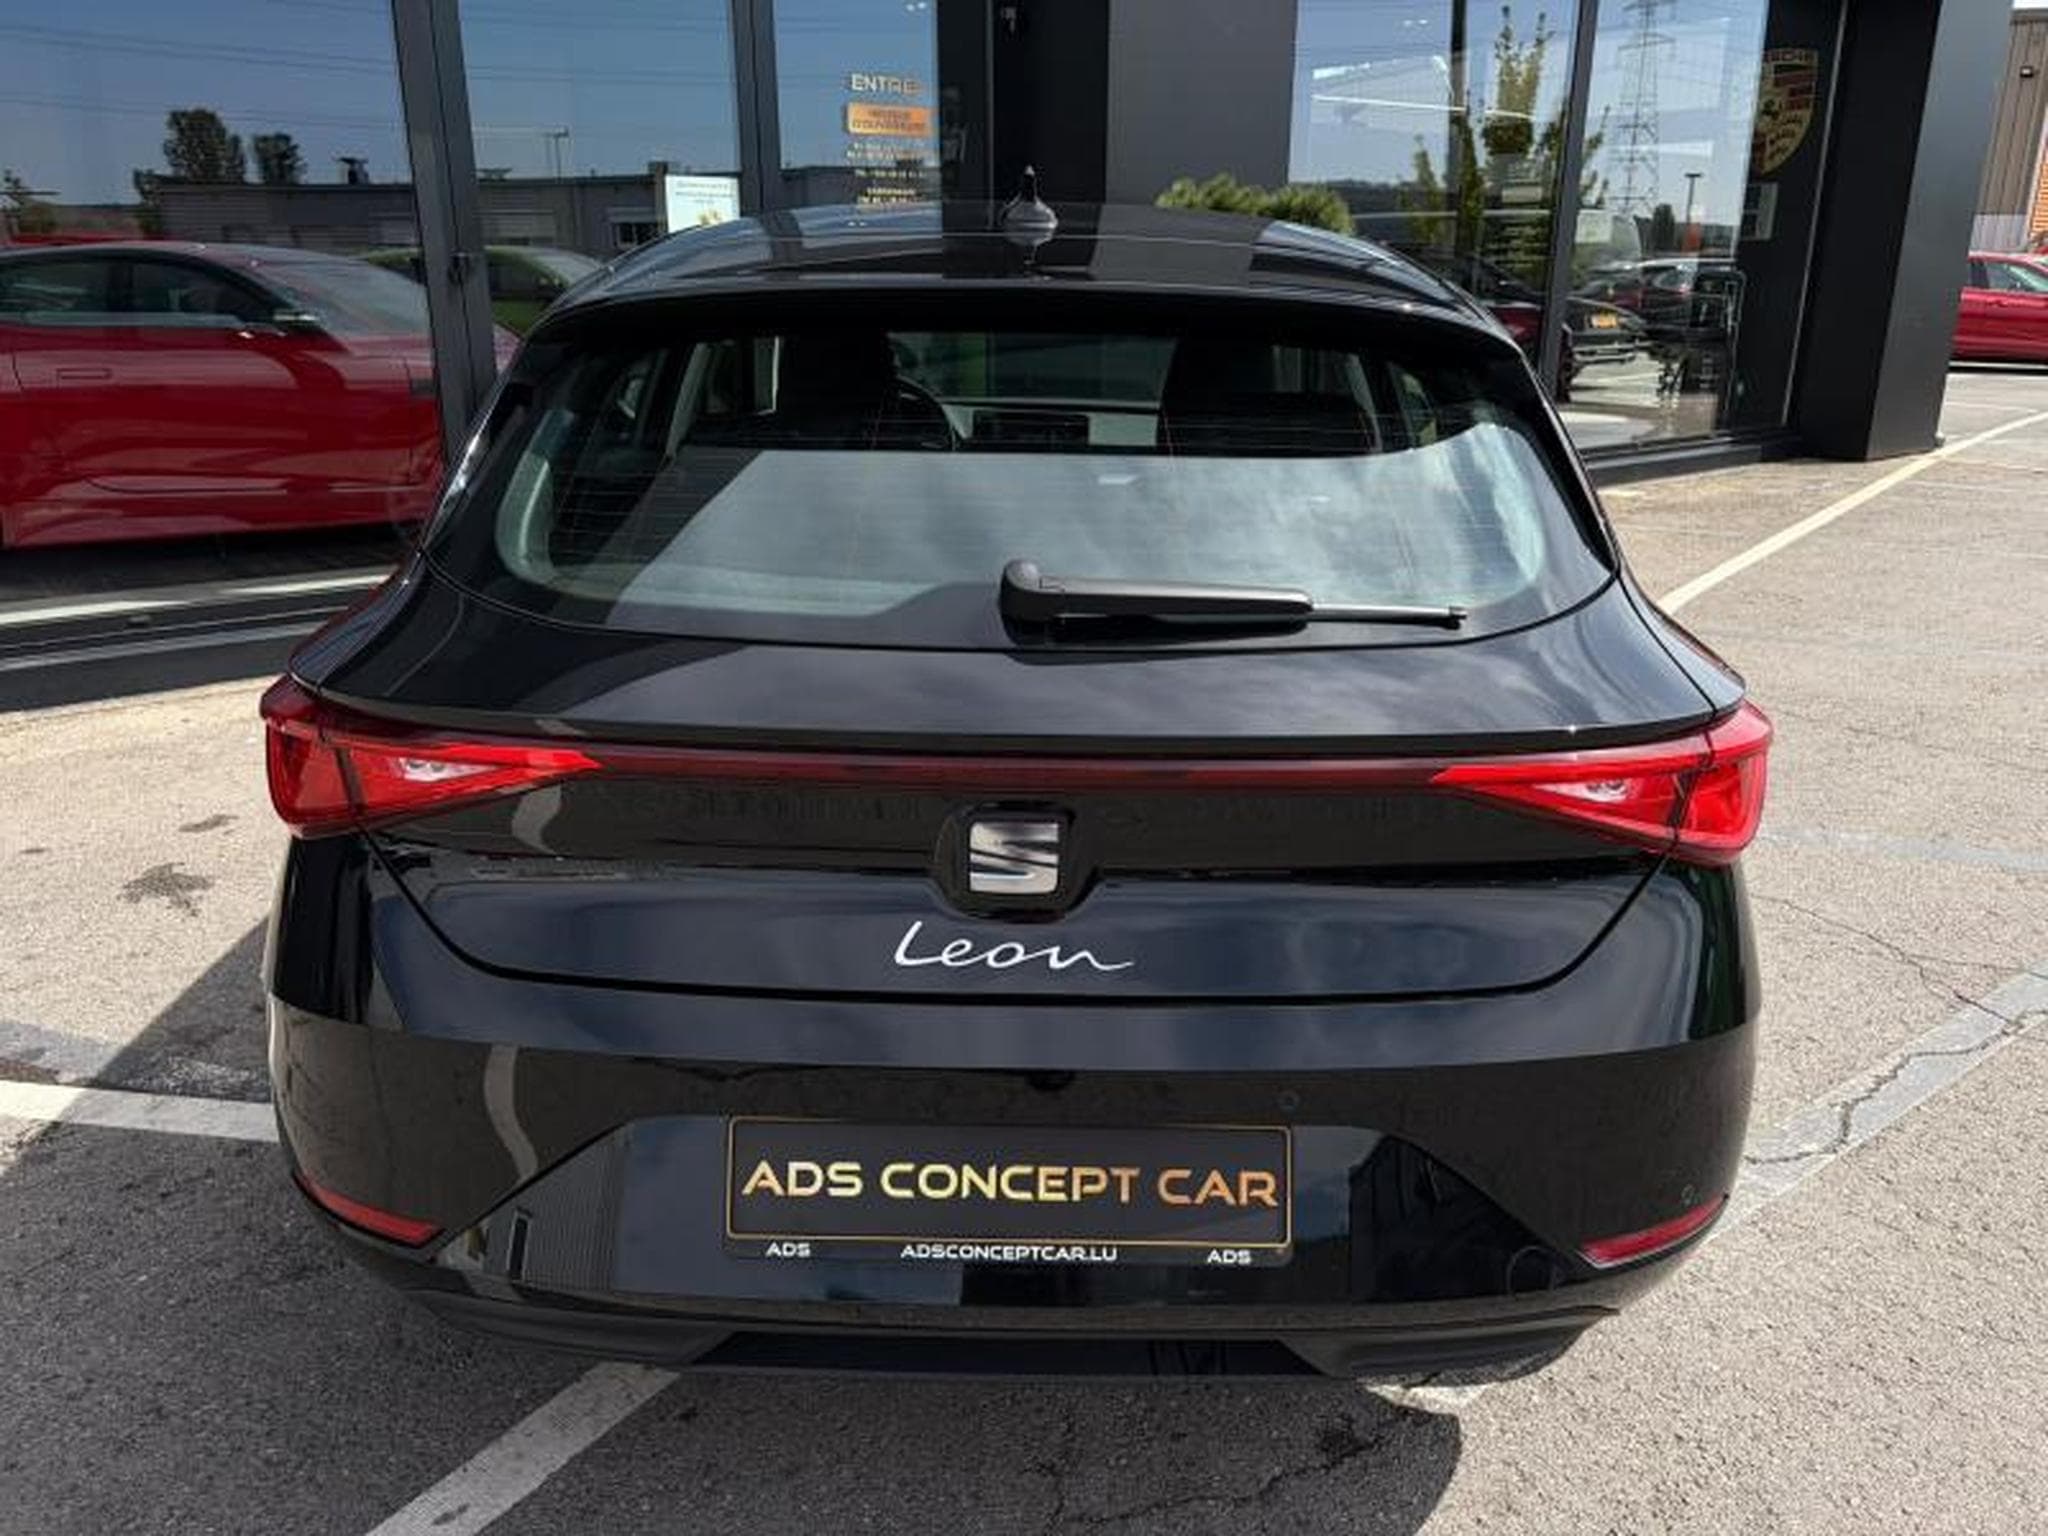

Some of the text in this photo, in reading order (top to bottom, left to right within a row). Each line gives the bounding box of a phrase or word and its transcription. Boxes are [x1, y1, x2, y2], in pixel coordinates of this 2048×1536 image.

[894, 920, 1135, 970] Leon
[742, 1159, 1279, 1207] ADS CONCEPT CAR
[766, 1243, 812, 1258] ADS
[900, 1244, 1118, 1262] ADSCONCEPTCAR.LU
[1206, 1249, 1253, 1265] ADS
